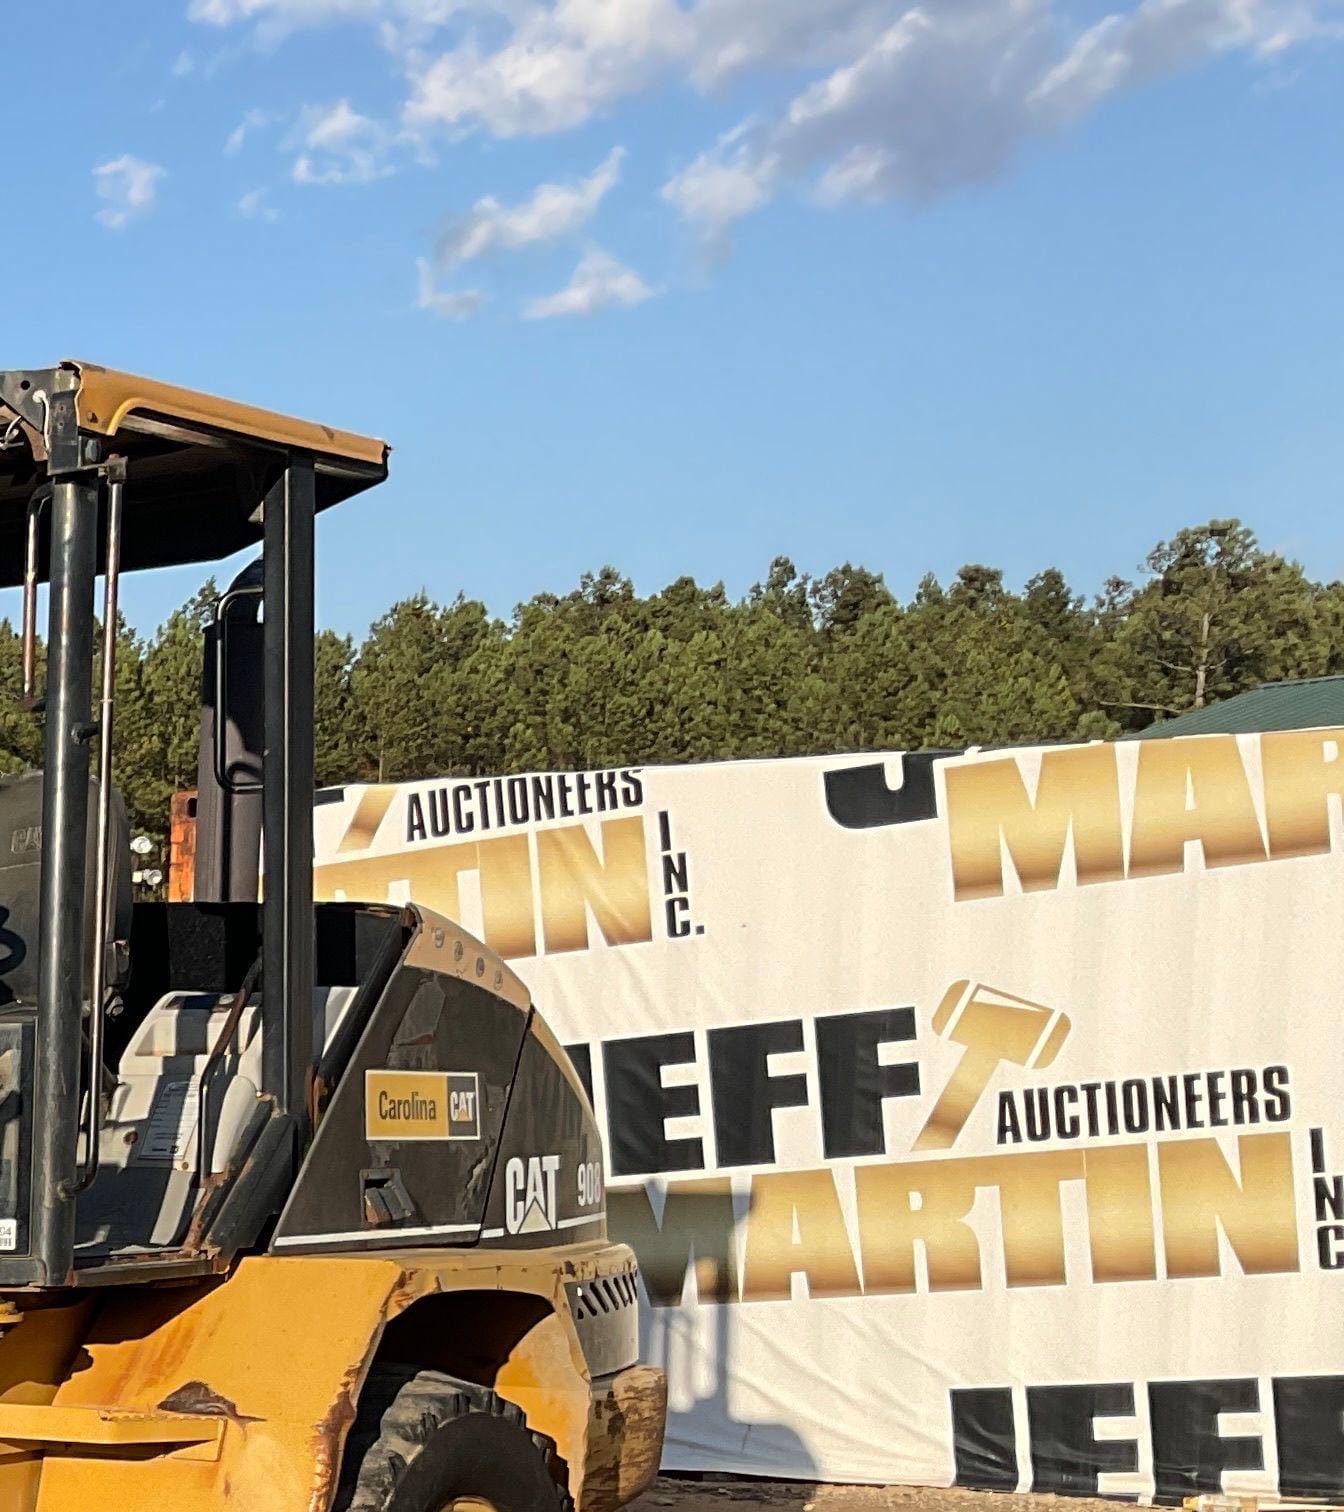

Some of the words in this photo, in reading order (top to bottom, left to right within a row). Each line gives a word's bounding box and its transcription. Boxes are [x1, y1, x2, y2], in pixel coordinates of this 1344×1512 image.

[407, 769, 643, 843] AUCTIONEERS
[659, 810, 705, 939] INC.
[378, 1090, 438, 1122] Carolina
[450, 1091, 475, 1122] CAT
[564, 1006, 921, 1177] EFF
[996, 1065, 1292, 1145] AUCTIONEERS
[505, 1155, 560, 1234] CAT
[577, 1162, 601, 1206] 908
[606, 1131, 1301, 1308] MARTIN
